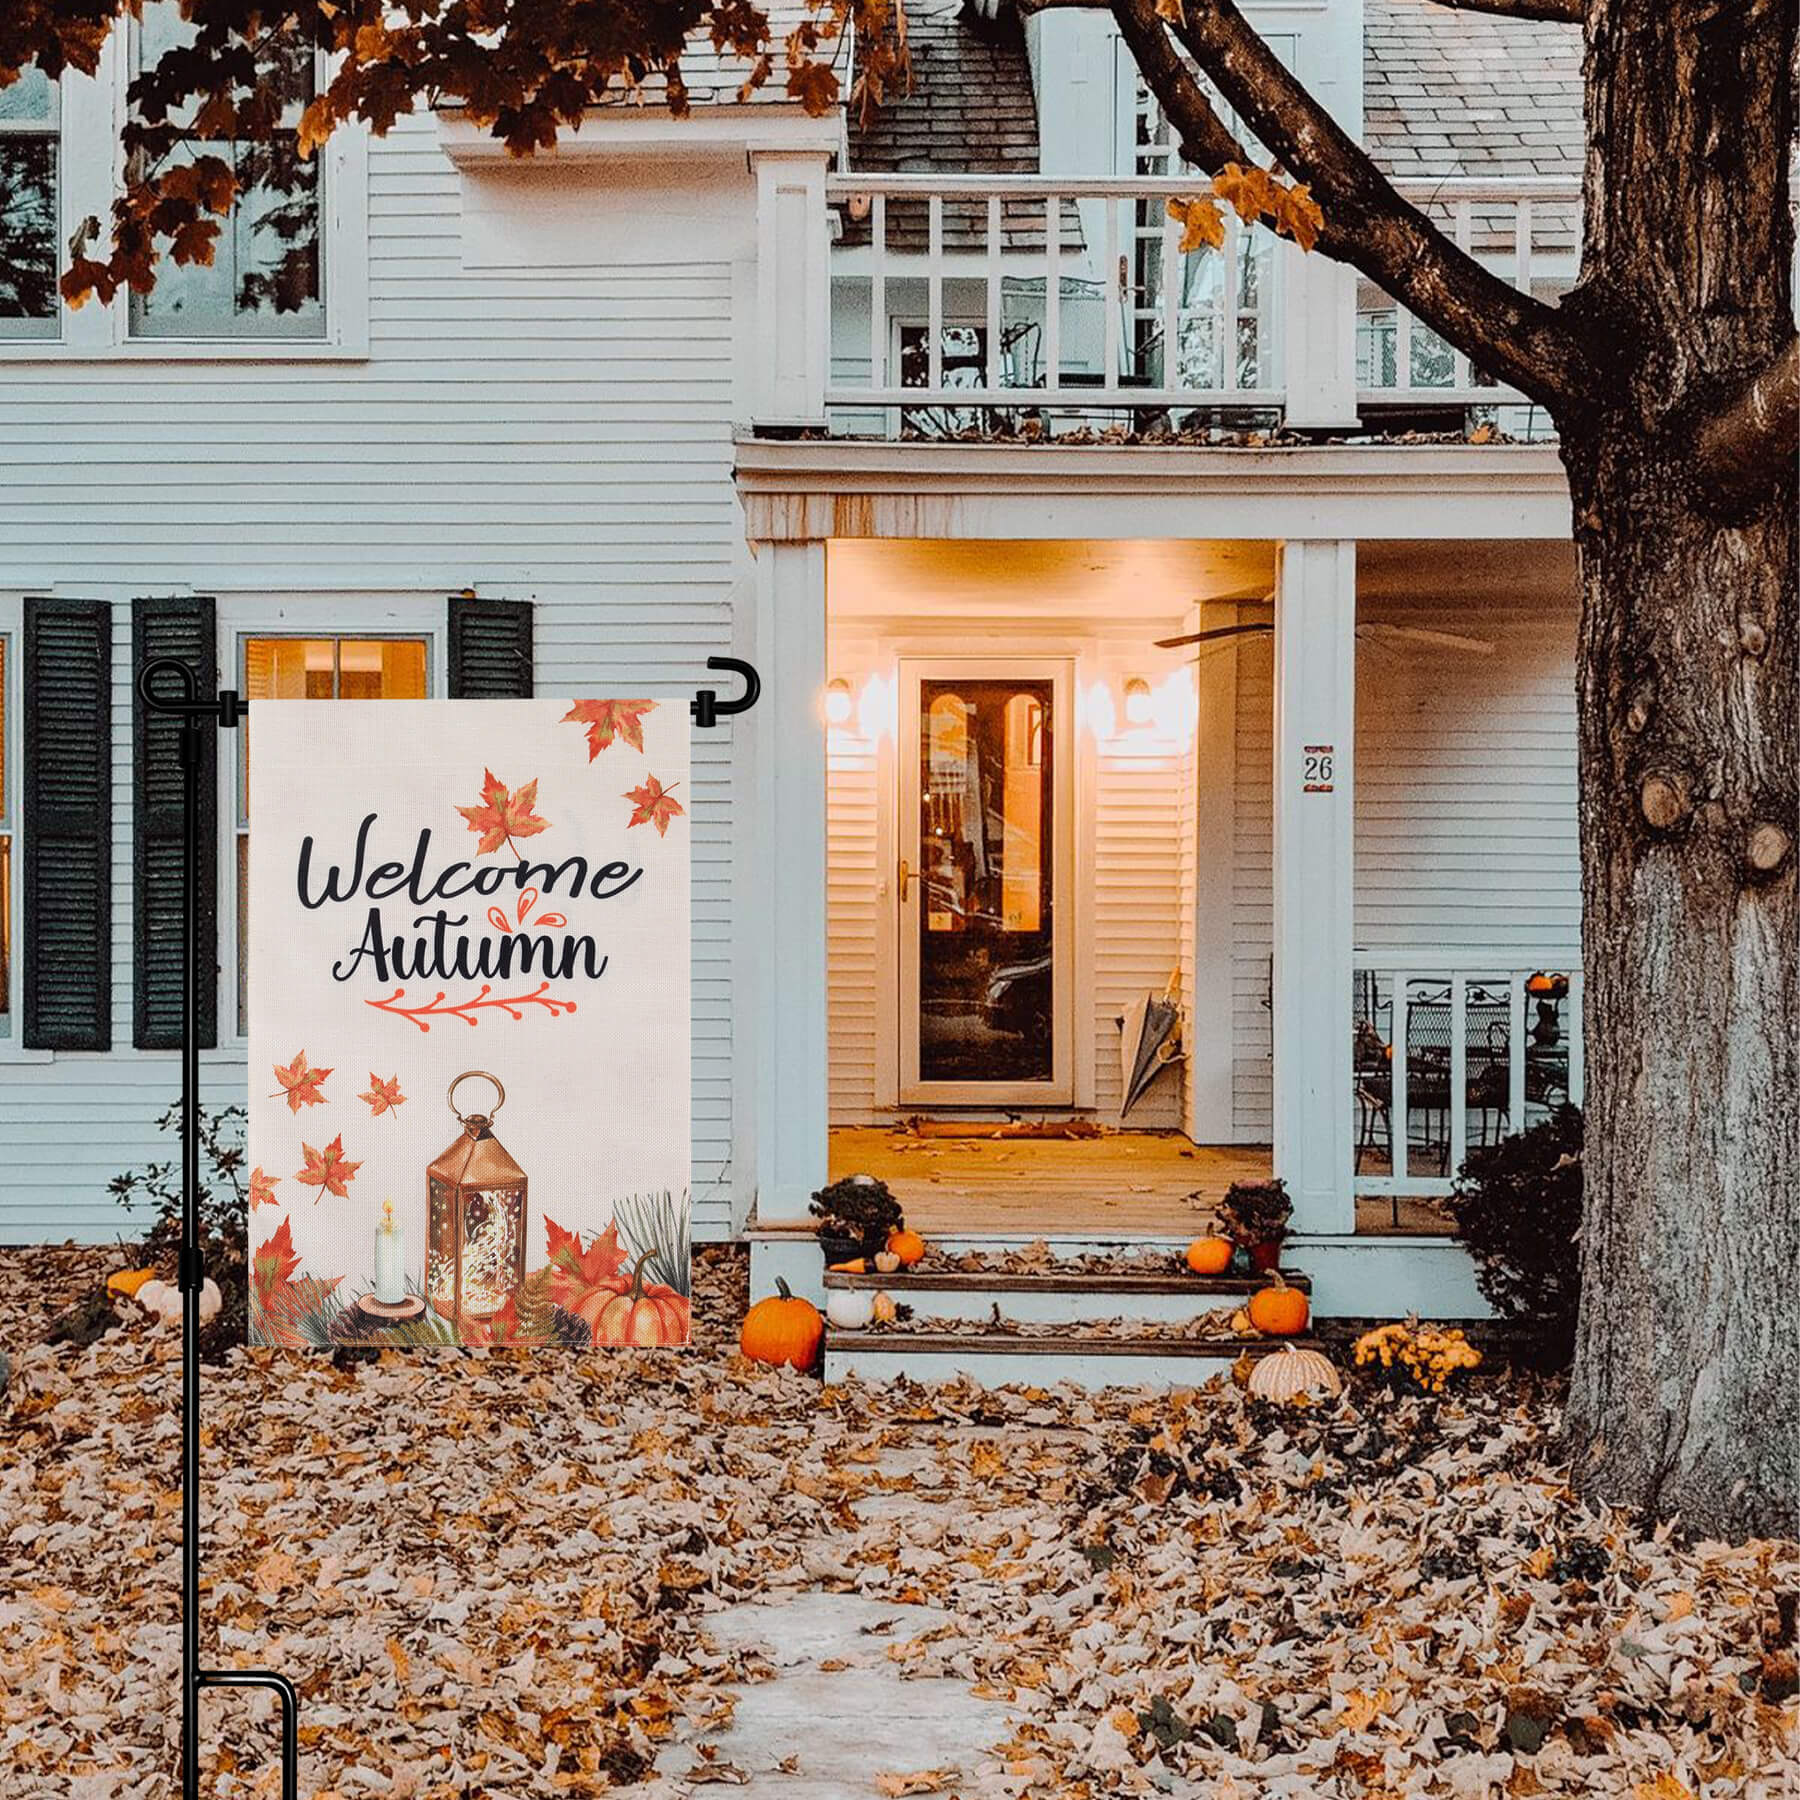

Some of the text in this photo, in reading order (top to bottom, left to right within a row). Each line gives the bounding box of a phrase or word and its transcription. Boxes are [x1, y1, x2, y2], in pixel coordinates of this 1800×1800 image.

[1304, 756, 1332, 780] 26
[298, 813, 644, 909] Welcome
[332, 908, 608, 982] Autumn
